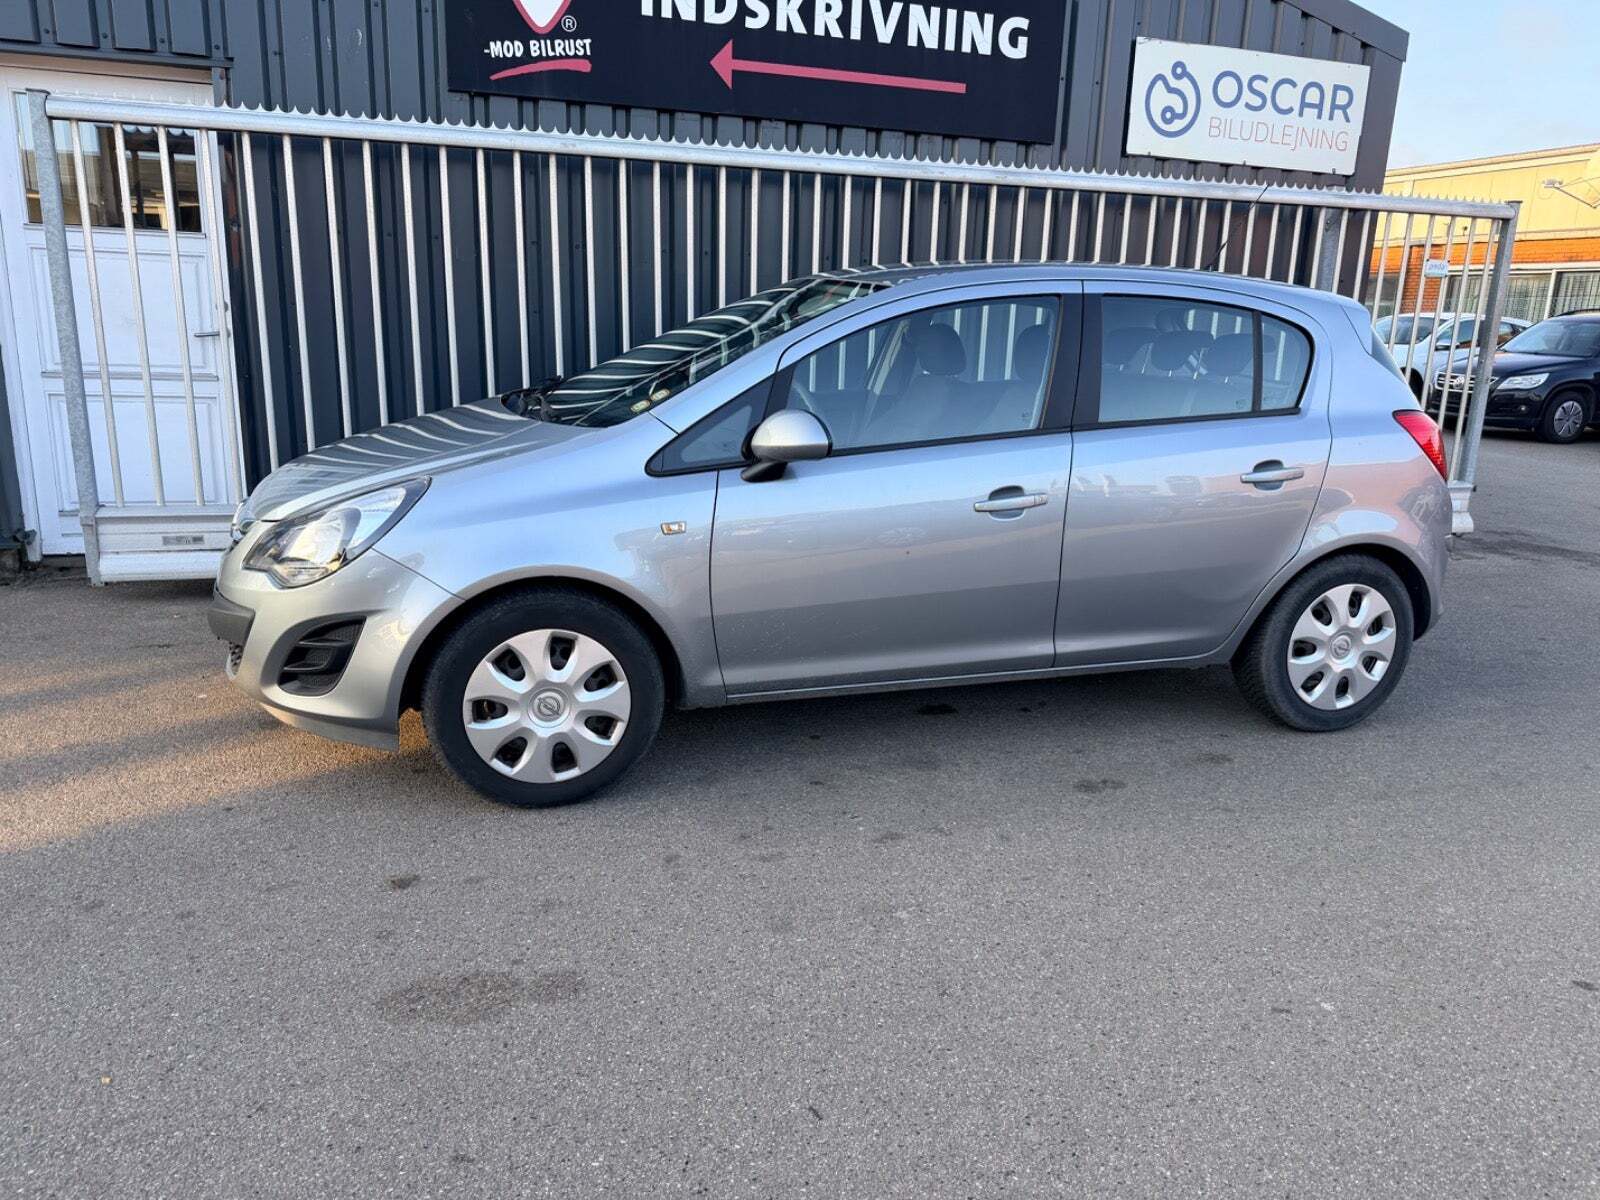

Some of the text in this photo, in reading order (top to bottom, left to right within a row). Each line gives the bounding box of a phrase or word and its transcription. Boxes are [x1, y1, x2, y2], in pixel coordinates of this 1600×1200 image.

[529, 38, 592, 57] BILRUST
[1212, 70, 1354, 123] OSCAR
[1208, 116, 1349, 151] BILUDLEJNING
